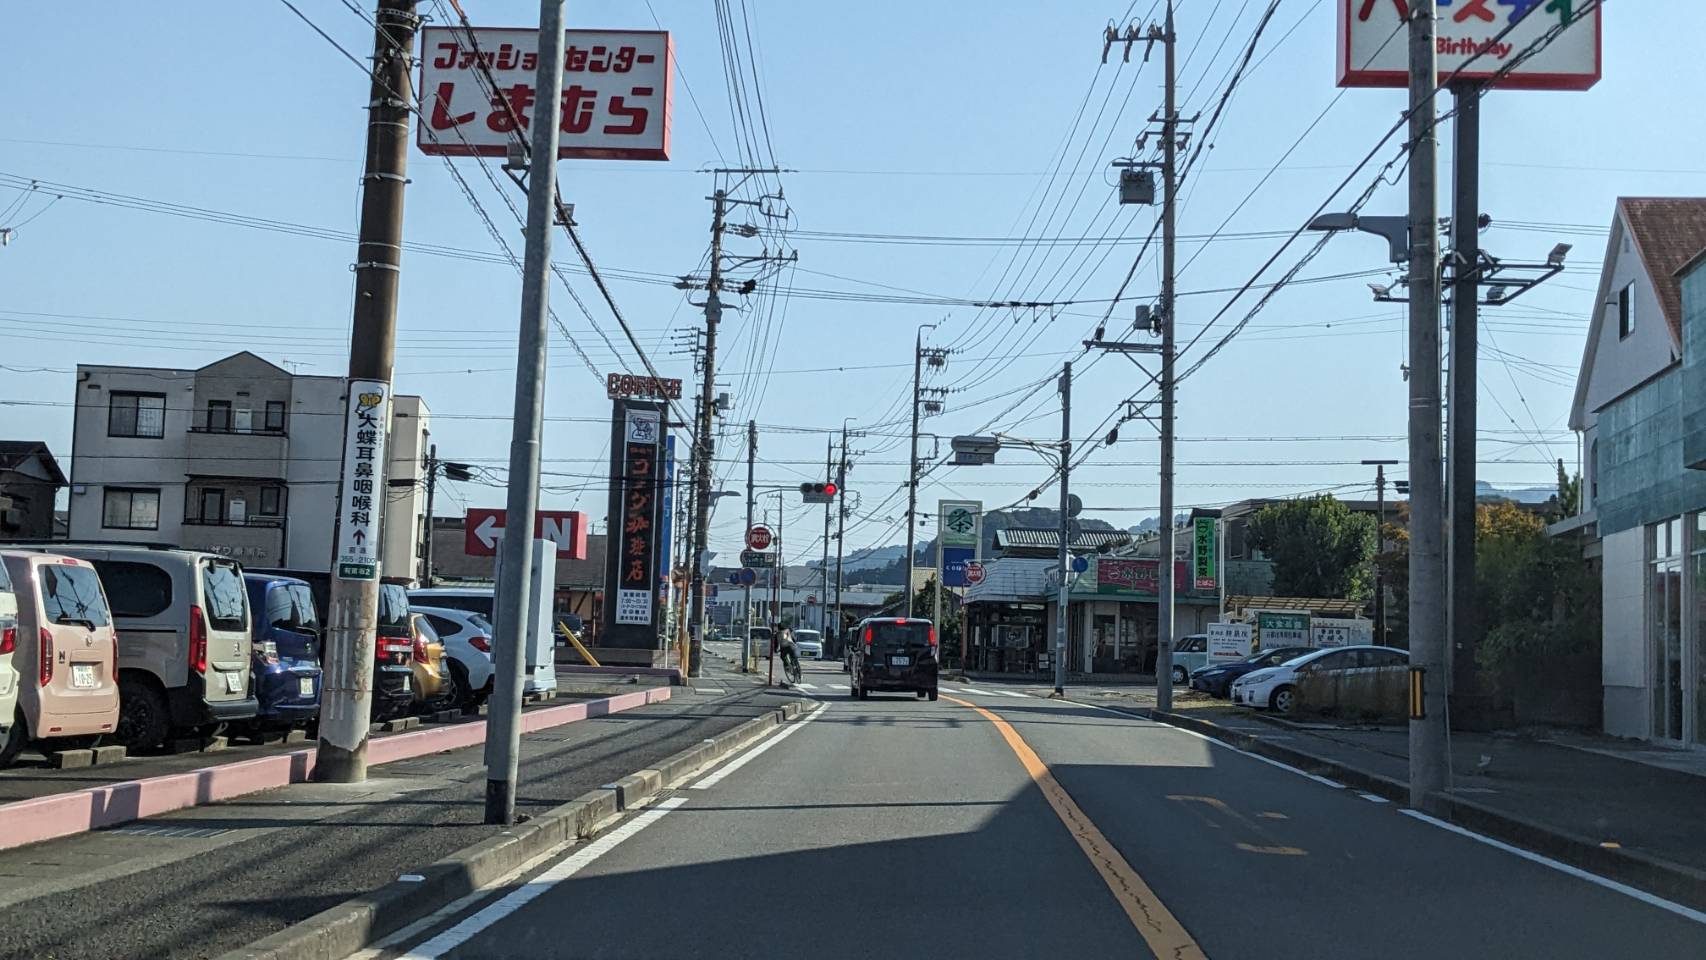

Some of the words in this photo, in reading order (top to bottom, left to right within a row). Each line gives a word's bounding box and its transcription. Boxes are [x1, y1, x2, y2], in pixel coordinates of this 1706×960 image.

[434, 43, 654, 73] ファッショセンター
[1436, 36, 1512, 59] Birthday
[431, 82, 654, 135] しまむら
[608, 374, 682, 398] COFFEE
[350, 413, 377, 527] 大蝶耳鼻咽喉科
